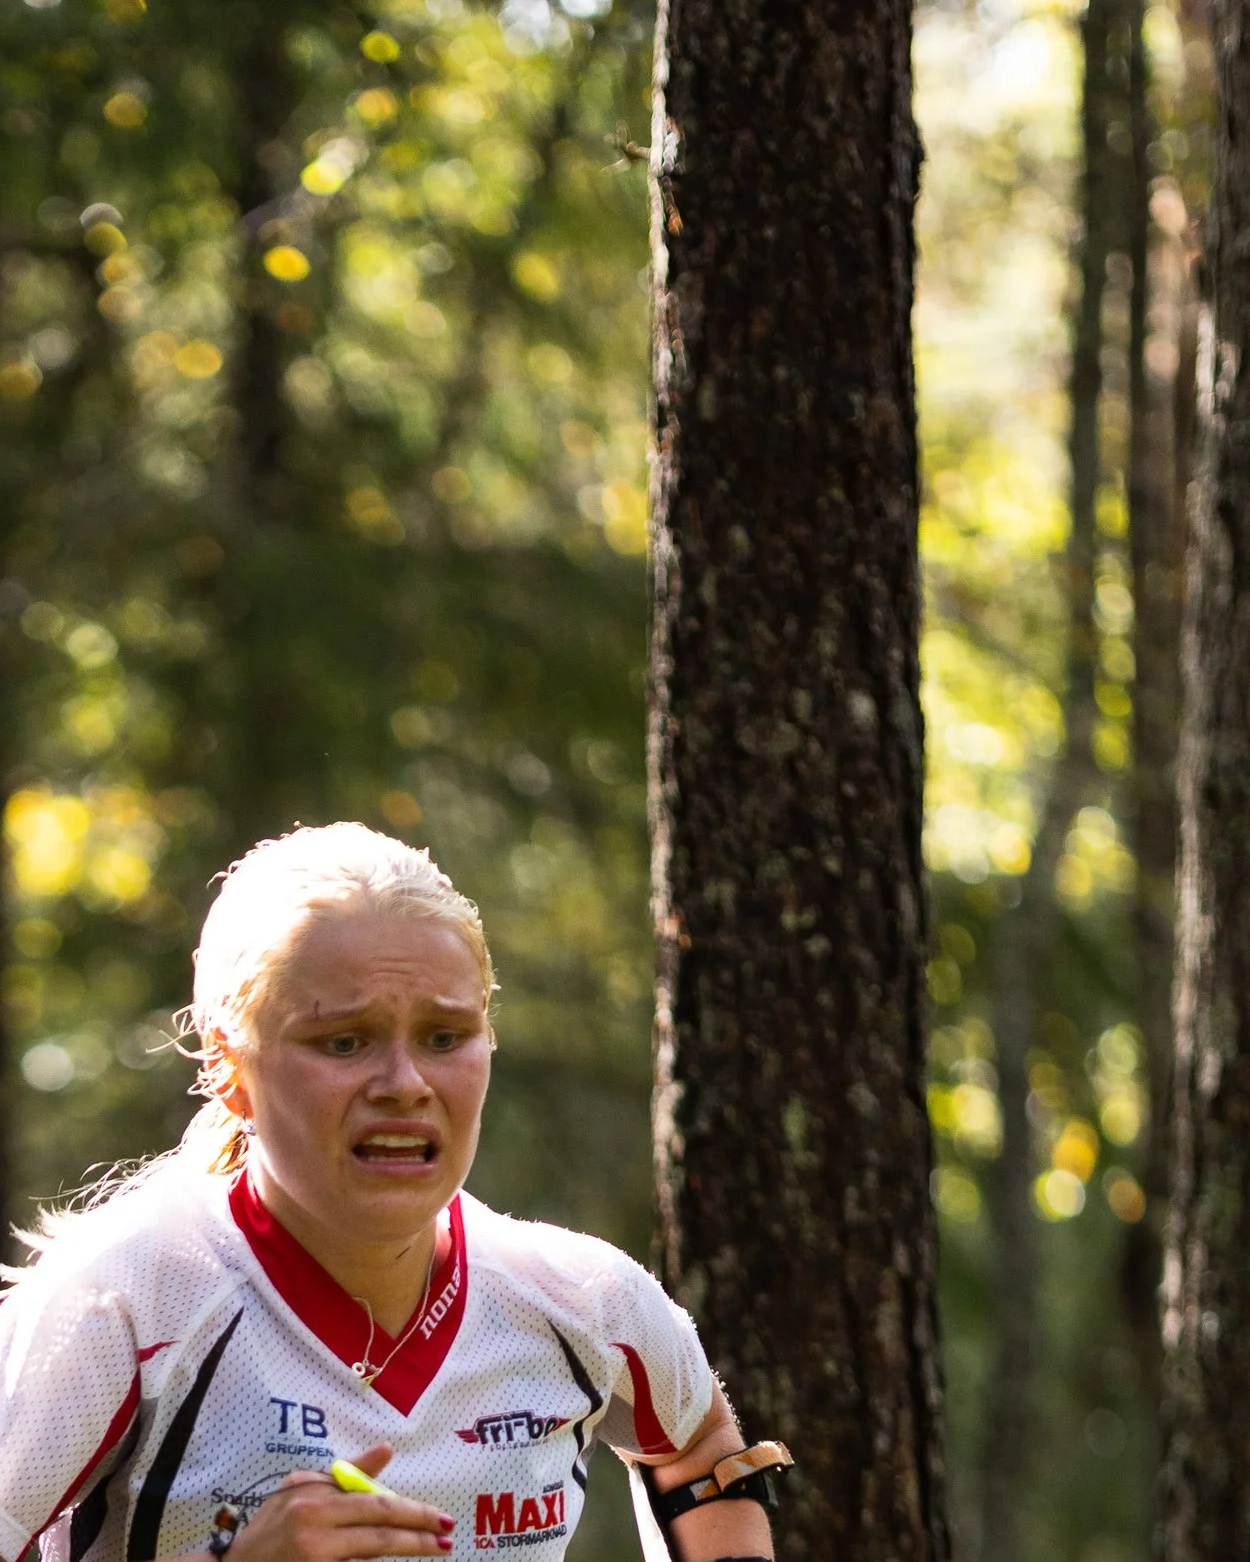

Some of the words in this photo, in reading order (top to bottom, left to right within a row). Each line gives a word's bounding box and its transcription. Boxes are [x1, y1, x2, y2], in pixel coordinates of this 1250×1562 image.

[269, 1397, 328, 1438] TB
[265, 1442, 335, 1458] GRUPPEN
[475, 1490, 565, 1536] MAXI
